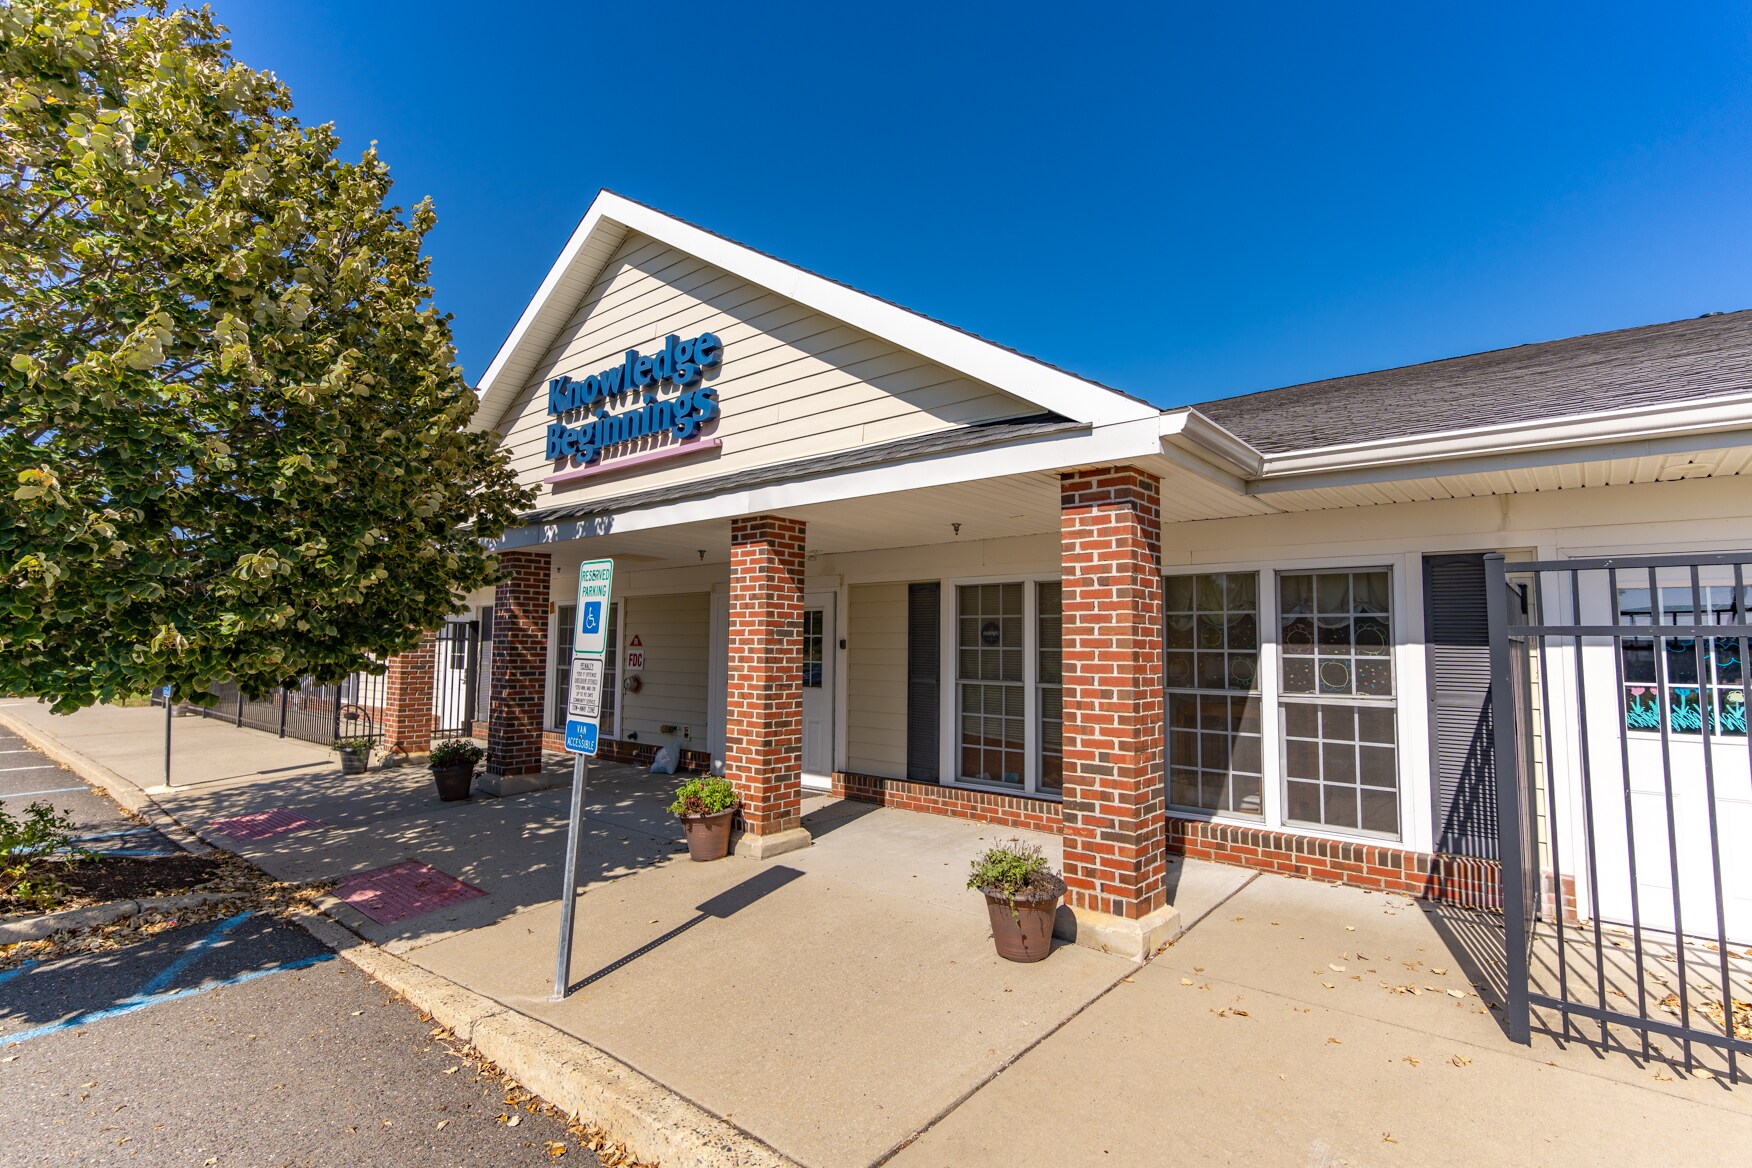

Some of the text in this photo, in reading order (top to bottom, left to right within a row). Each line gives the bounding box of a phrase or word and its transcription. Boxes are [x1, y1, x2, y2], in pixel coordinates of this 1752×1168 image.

[547, 332, 723, 417] Knowledge
[545, 387, 719, 463] Beginnings
[582, 569, 609, 581] RESERVED
[582, 585, 606, 596] PARKING
[581, 662, 593, 670] PENALTY
[629, 653, 643, 667] FDC
[577, 725, 587, 734] VAN
[567, 737, 594, 750] ACCESSIBLE
